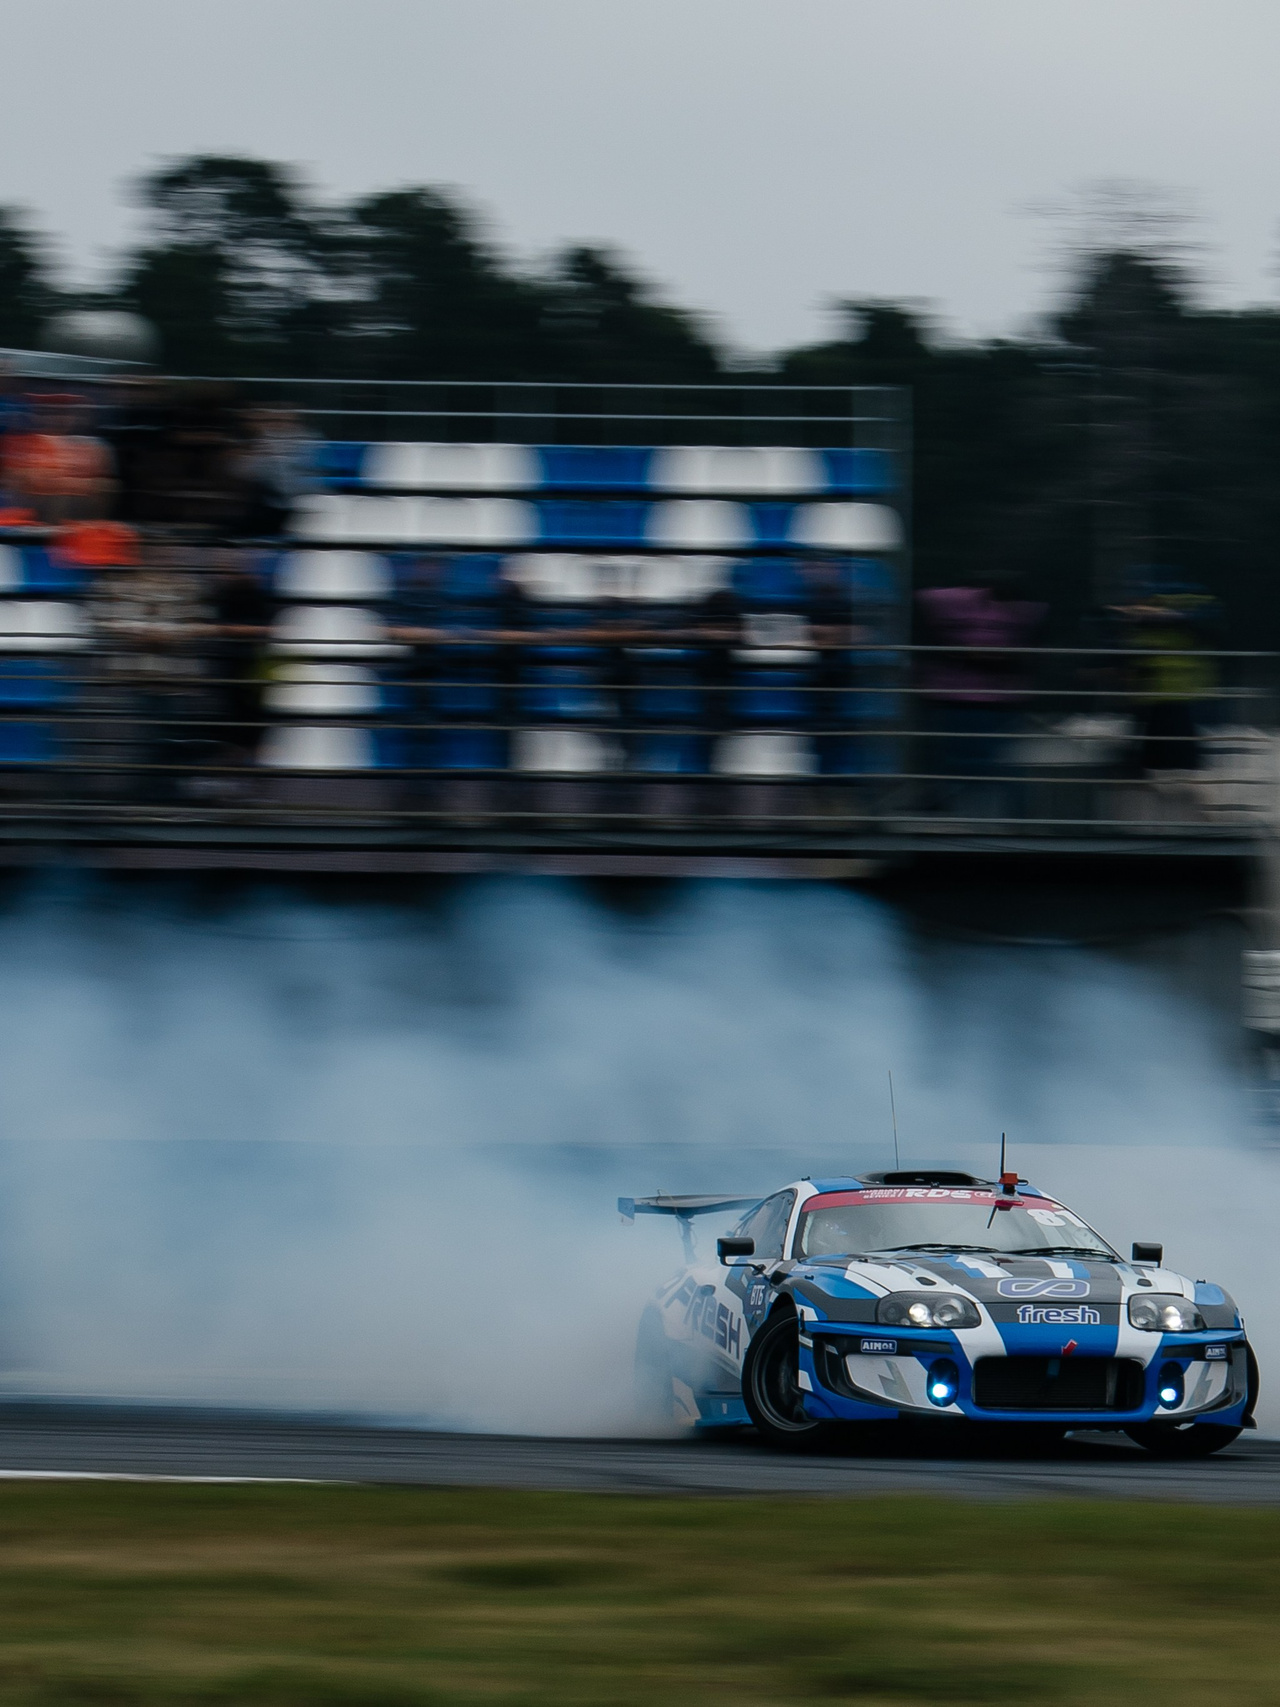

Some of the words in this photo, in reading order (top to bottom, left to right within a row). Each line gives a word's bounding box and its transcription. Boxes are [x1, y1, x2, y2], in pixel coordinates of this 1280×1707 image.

[1027, 1208, 1089, 1229] 81
[1017, 1305, 1101, 1324] fresh
[862, 1341, 895, 1351] AIMOL
